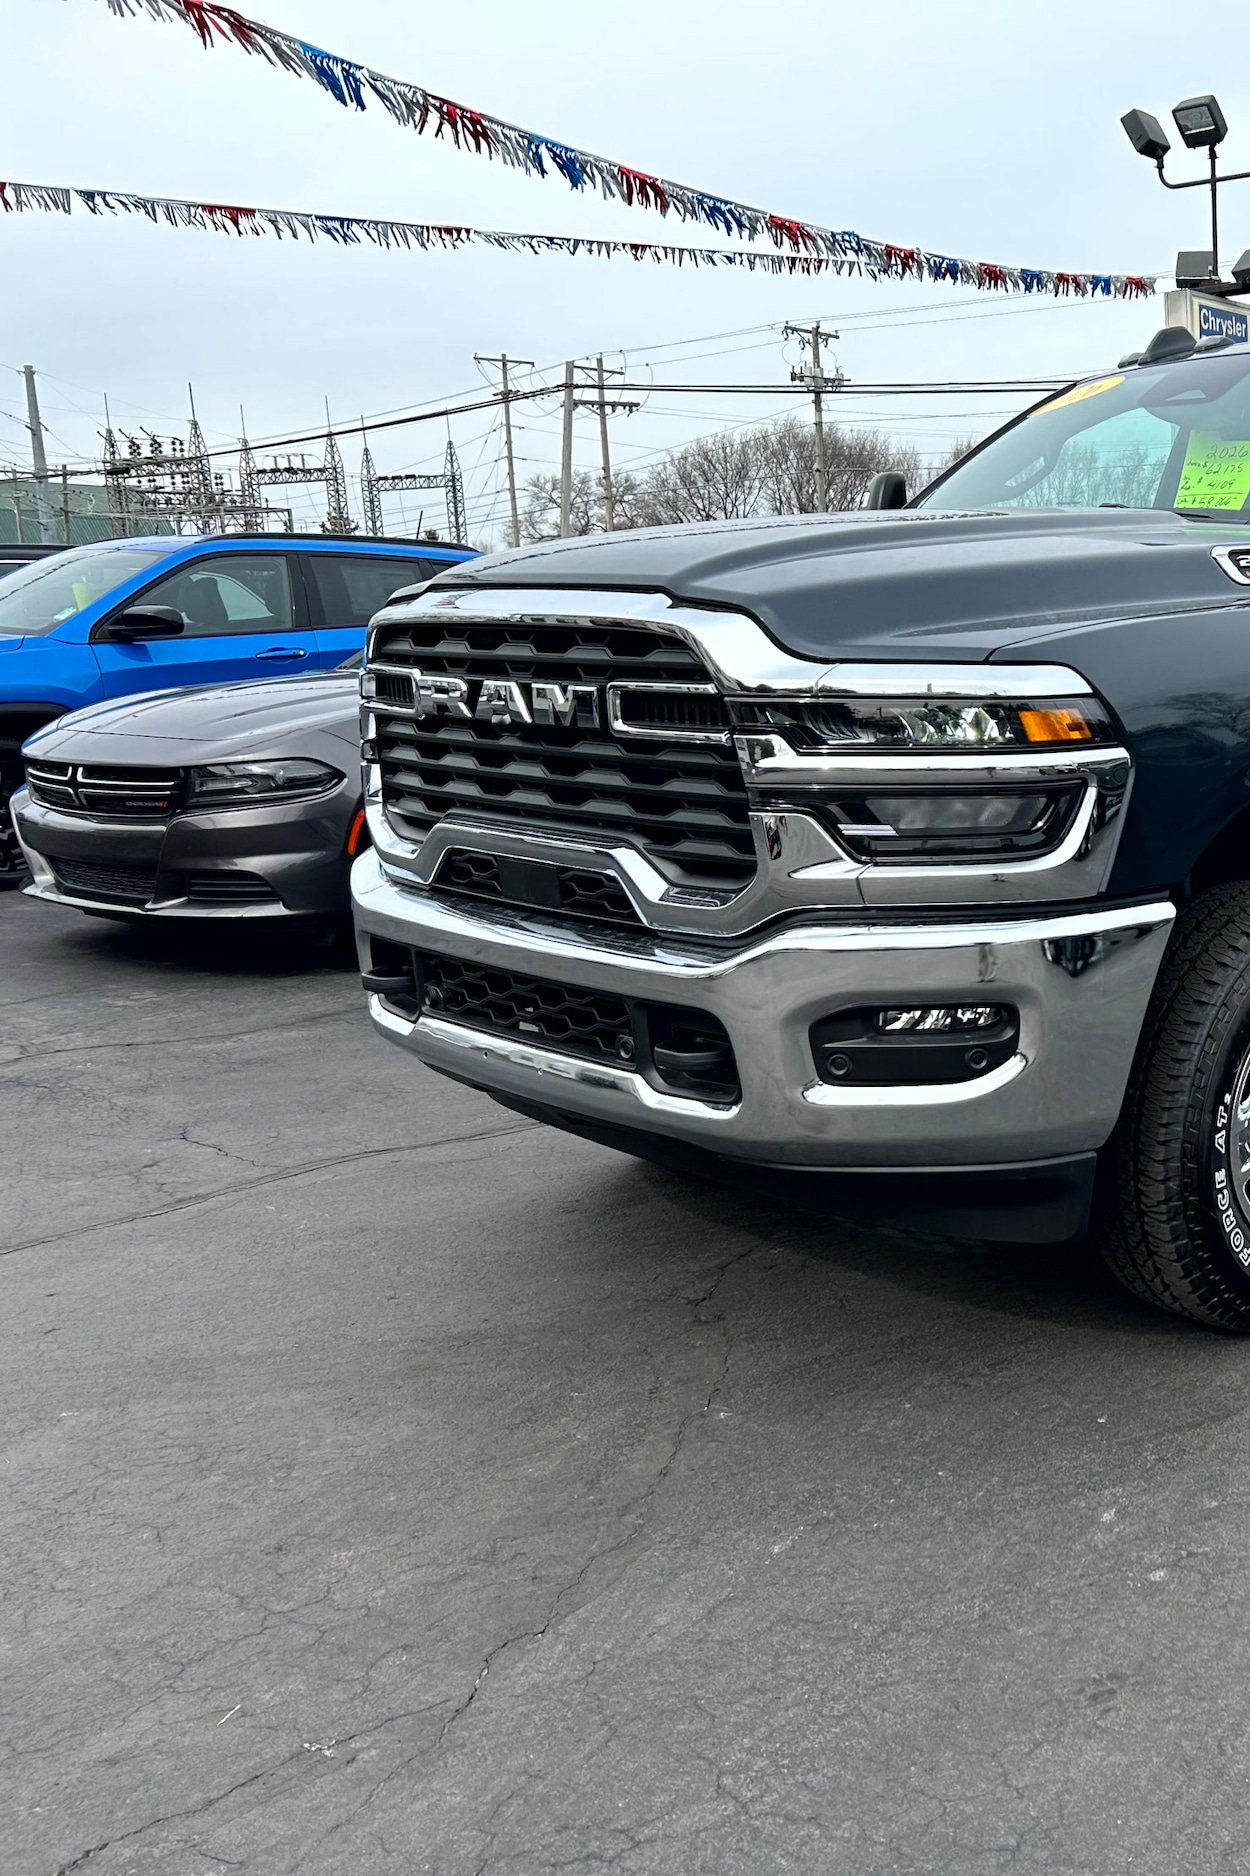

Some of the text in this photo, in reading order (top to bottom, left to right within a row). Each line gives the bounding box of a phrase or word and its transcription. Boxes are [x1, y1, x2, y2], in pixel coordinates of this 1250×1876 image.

[1200, 308, 1247, 338] Chrysler
[1206, 443, 1249, 460] 2026
[418, 675, 600, 729] RAM
